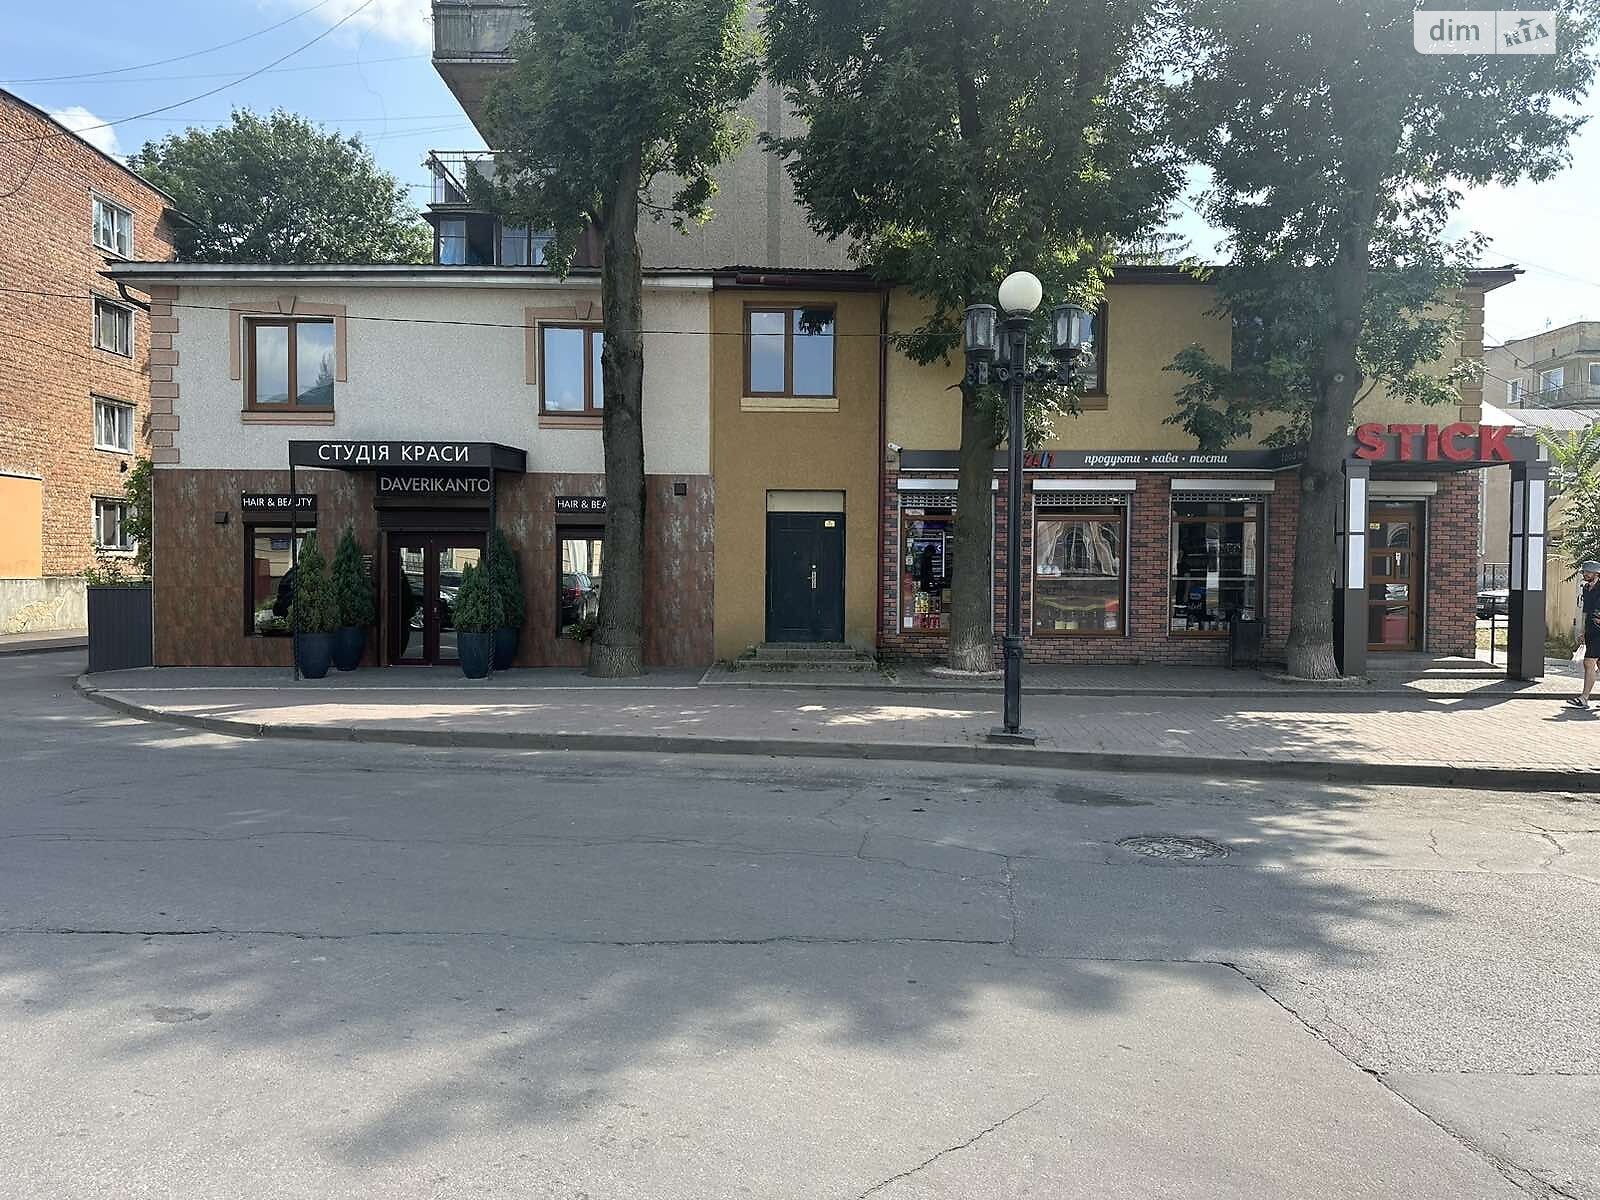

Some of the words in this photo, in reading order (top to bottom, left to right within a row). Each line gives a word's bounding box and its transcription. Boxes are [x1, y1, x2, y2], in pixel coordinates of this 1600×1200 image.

[1355, 422, 1514, 462] STICK
[317, 444, 390, 464] СТУДІЯ
[401, 445, 469, 462] КРАСИ
[1084, 454, 1141, 467] продукти
[1151, 451, 1179, 464] кава
[1189, 454, 1228, 464] тости
[380, 477, 490, 493] DAVERIKANTO
[242, 497, 265, 507] HAIR
[267, 497, 276, 507] &
[557, 499, 579, 509] HAIR
[581, 499, 589, 509] &
[591, 499, 607, 509] BEA
